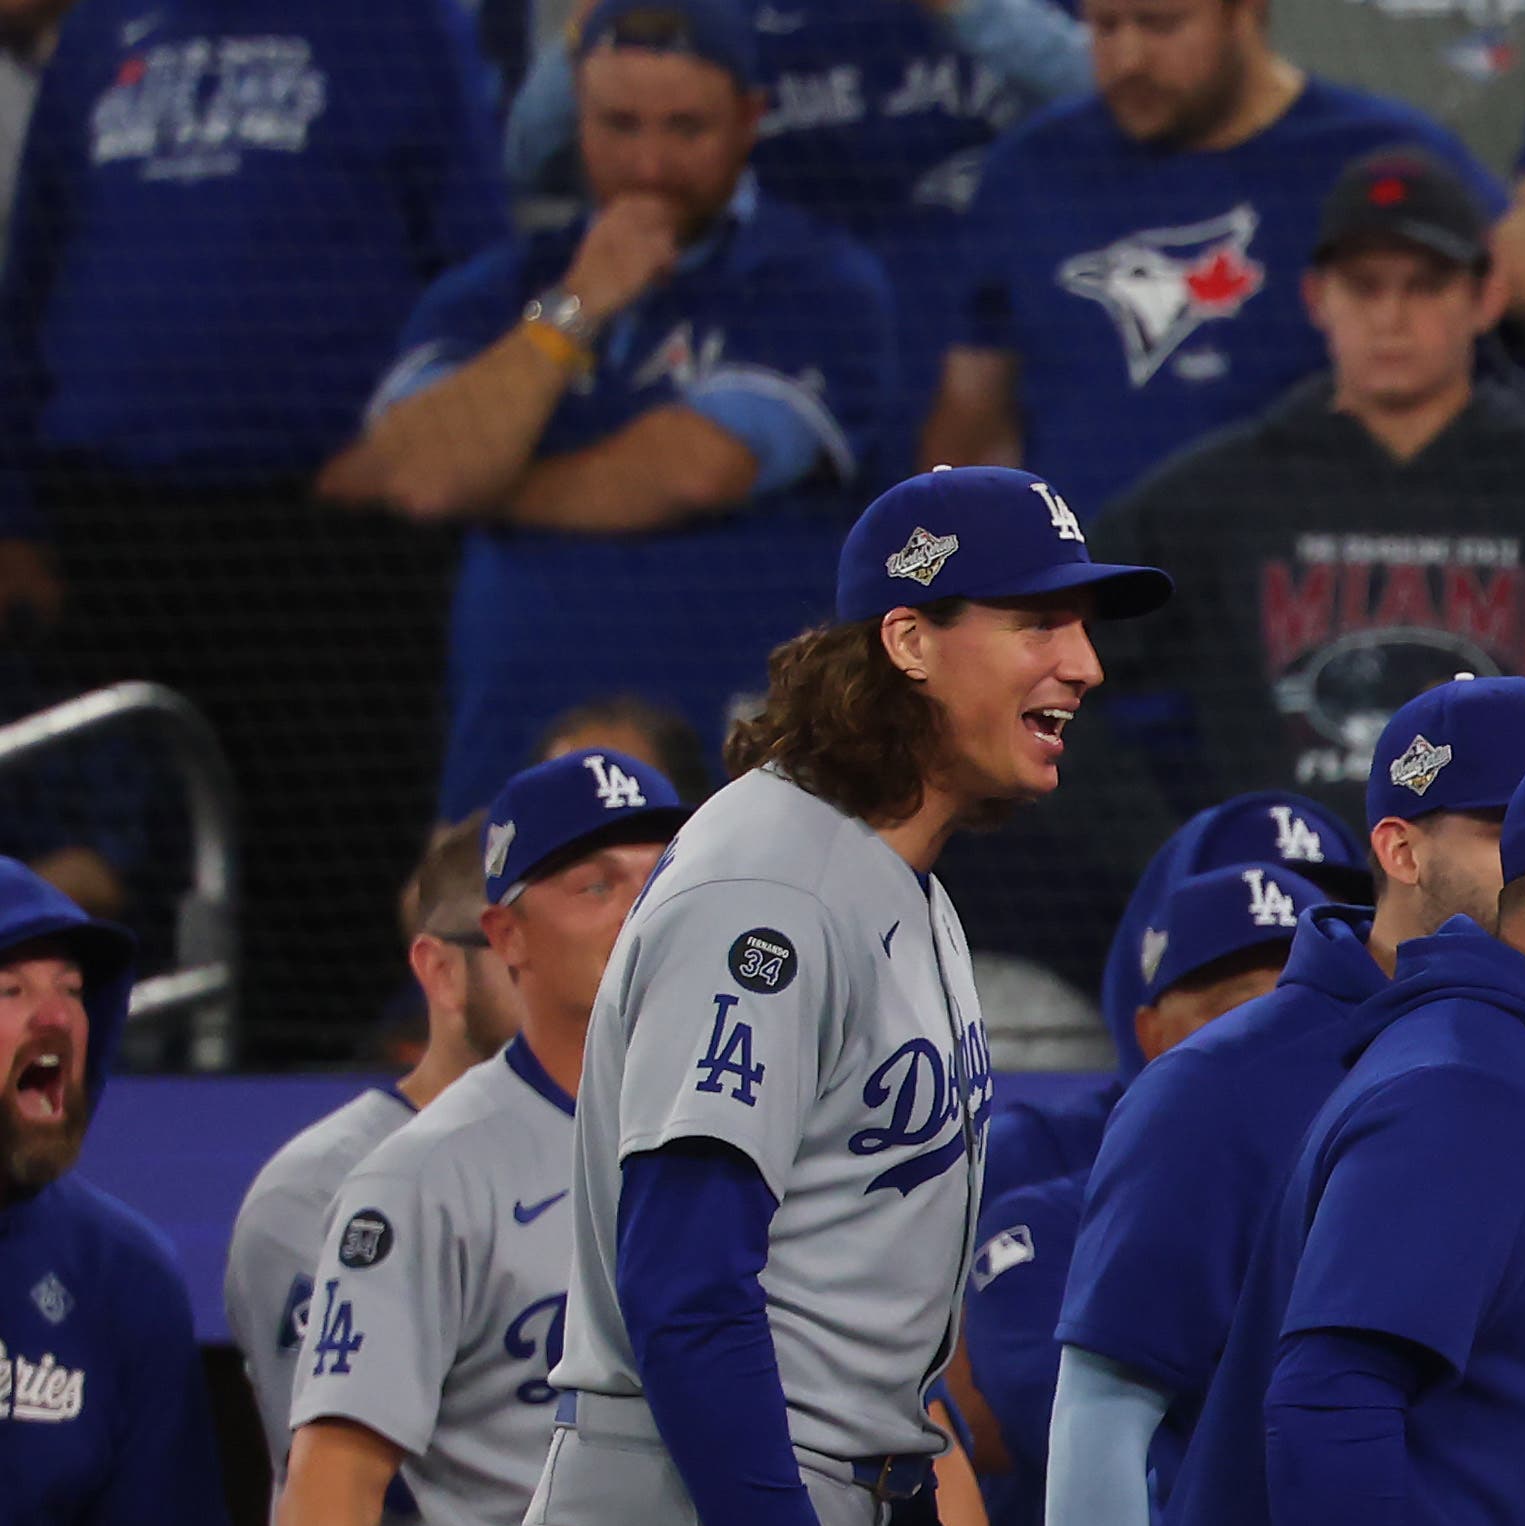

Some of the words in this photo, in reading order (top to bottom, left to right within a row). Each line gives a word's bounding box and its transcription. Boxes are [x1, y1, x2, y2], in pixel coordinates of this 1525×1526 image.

[1030, 482, 1085, 543] LA
[585, 755, 647, 808] LA
[1269, 806, 1325, 863] LA
[1241, 869, 1297, 927] LA
[739, 948, 783, 986] 34
[747, 936, 789, 959] FERNANDO
[696, 994, 766, 1107] LA
[312, 1278, 366, 1377] LA
